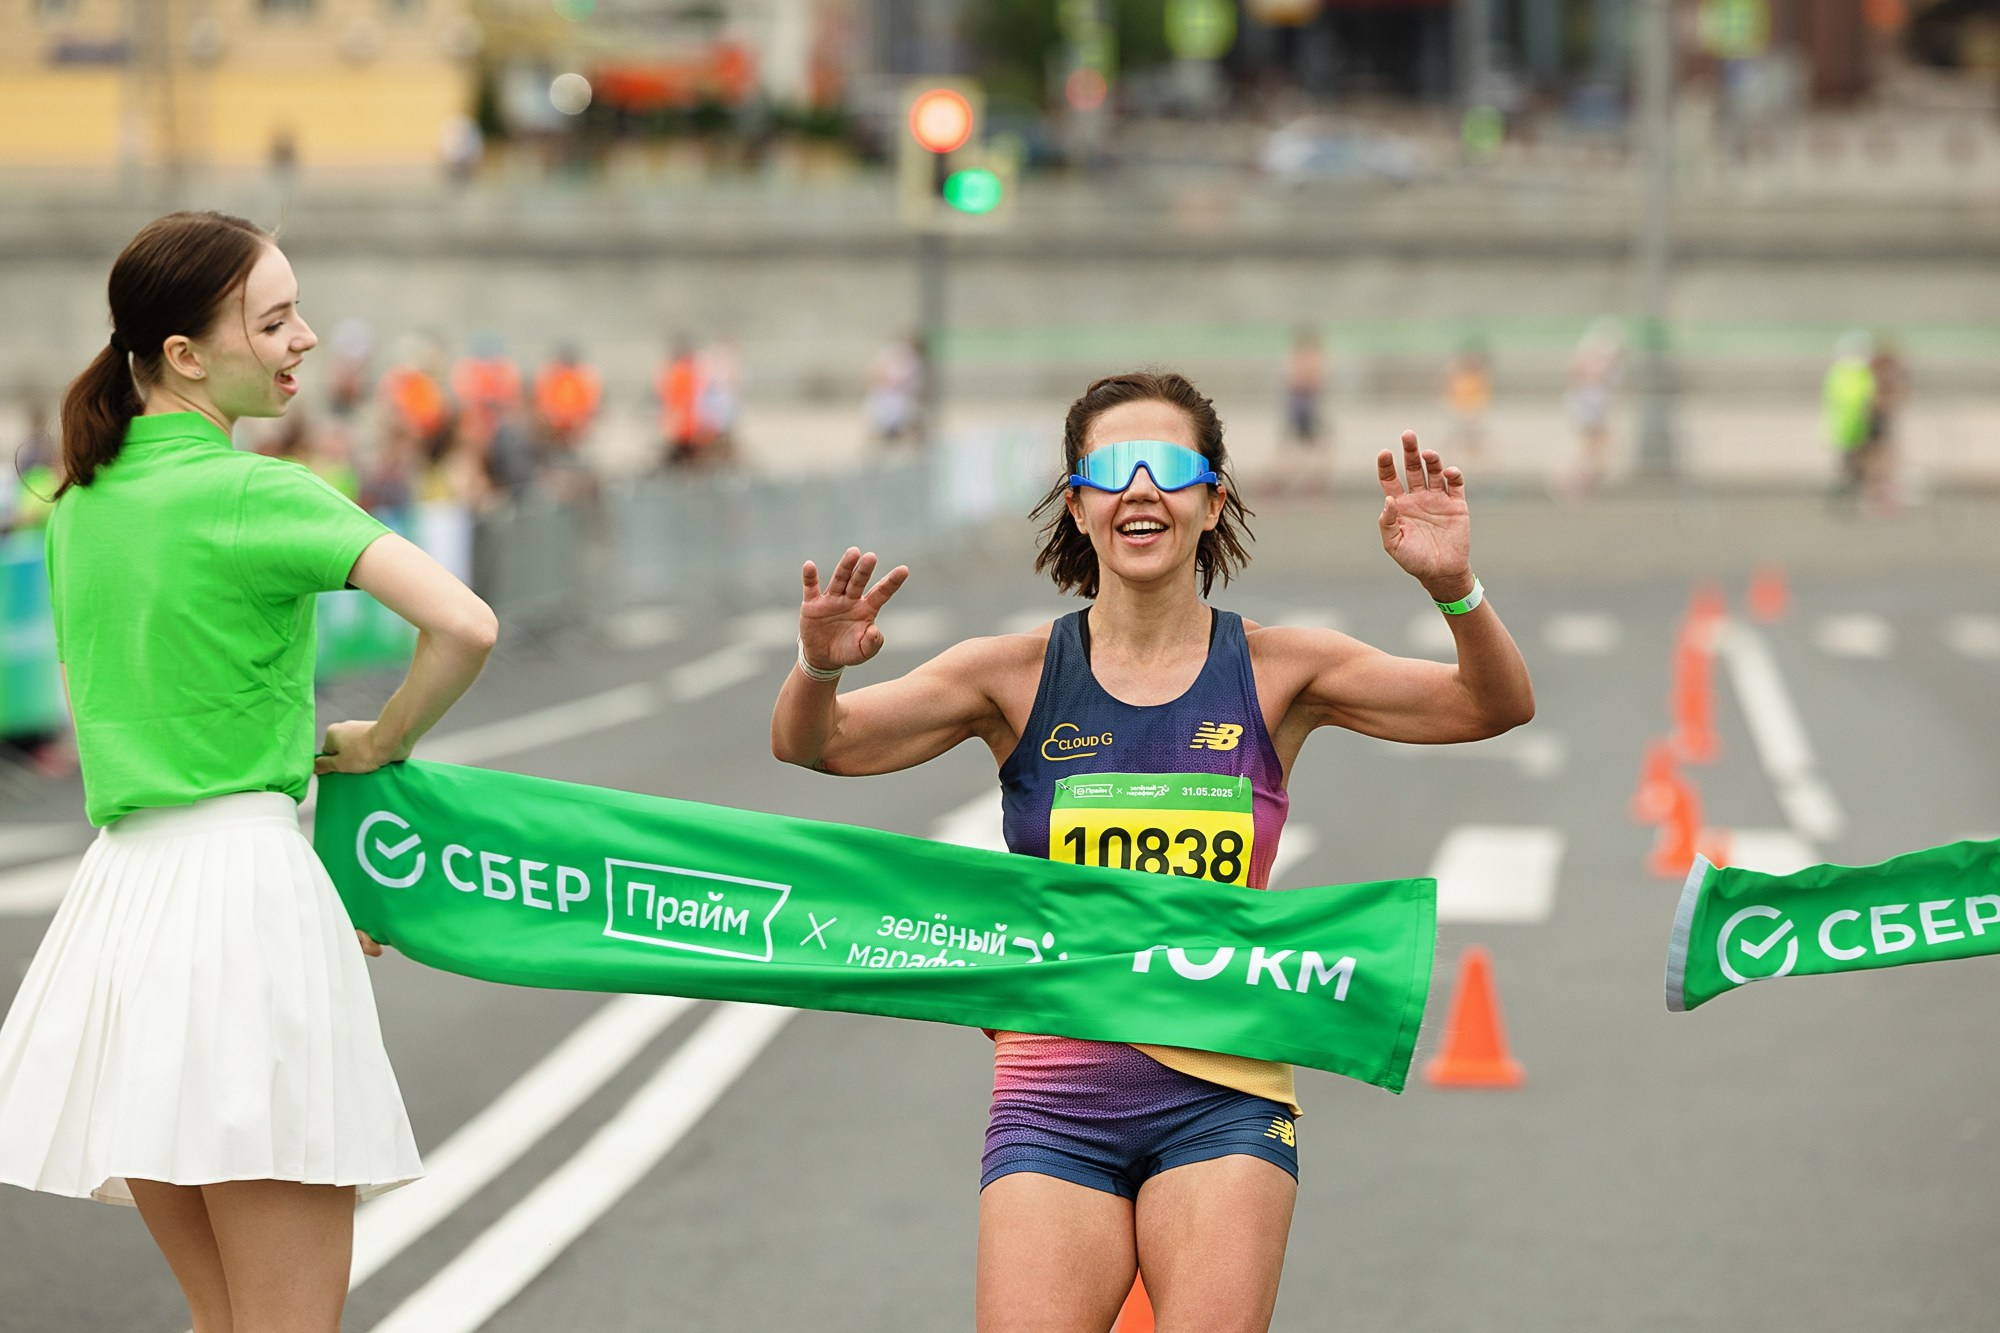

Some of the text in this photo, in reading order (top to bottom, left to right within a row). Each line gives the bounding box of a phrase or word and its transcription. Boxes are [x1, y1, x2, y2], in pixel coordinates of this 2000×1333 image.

[1058, 732, 1113, 751] CLOUD G
[1181, 787, 1233, 798] 31.05.2025
[1064, 826, 1244, 885] 10838
[441, 843, 592, 913] СБЕР
[626, 881, 750, 936] Прайм
[876, 912, 1008, 957] зелёный
[1817, 893, 2000, 961] СБЕР
